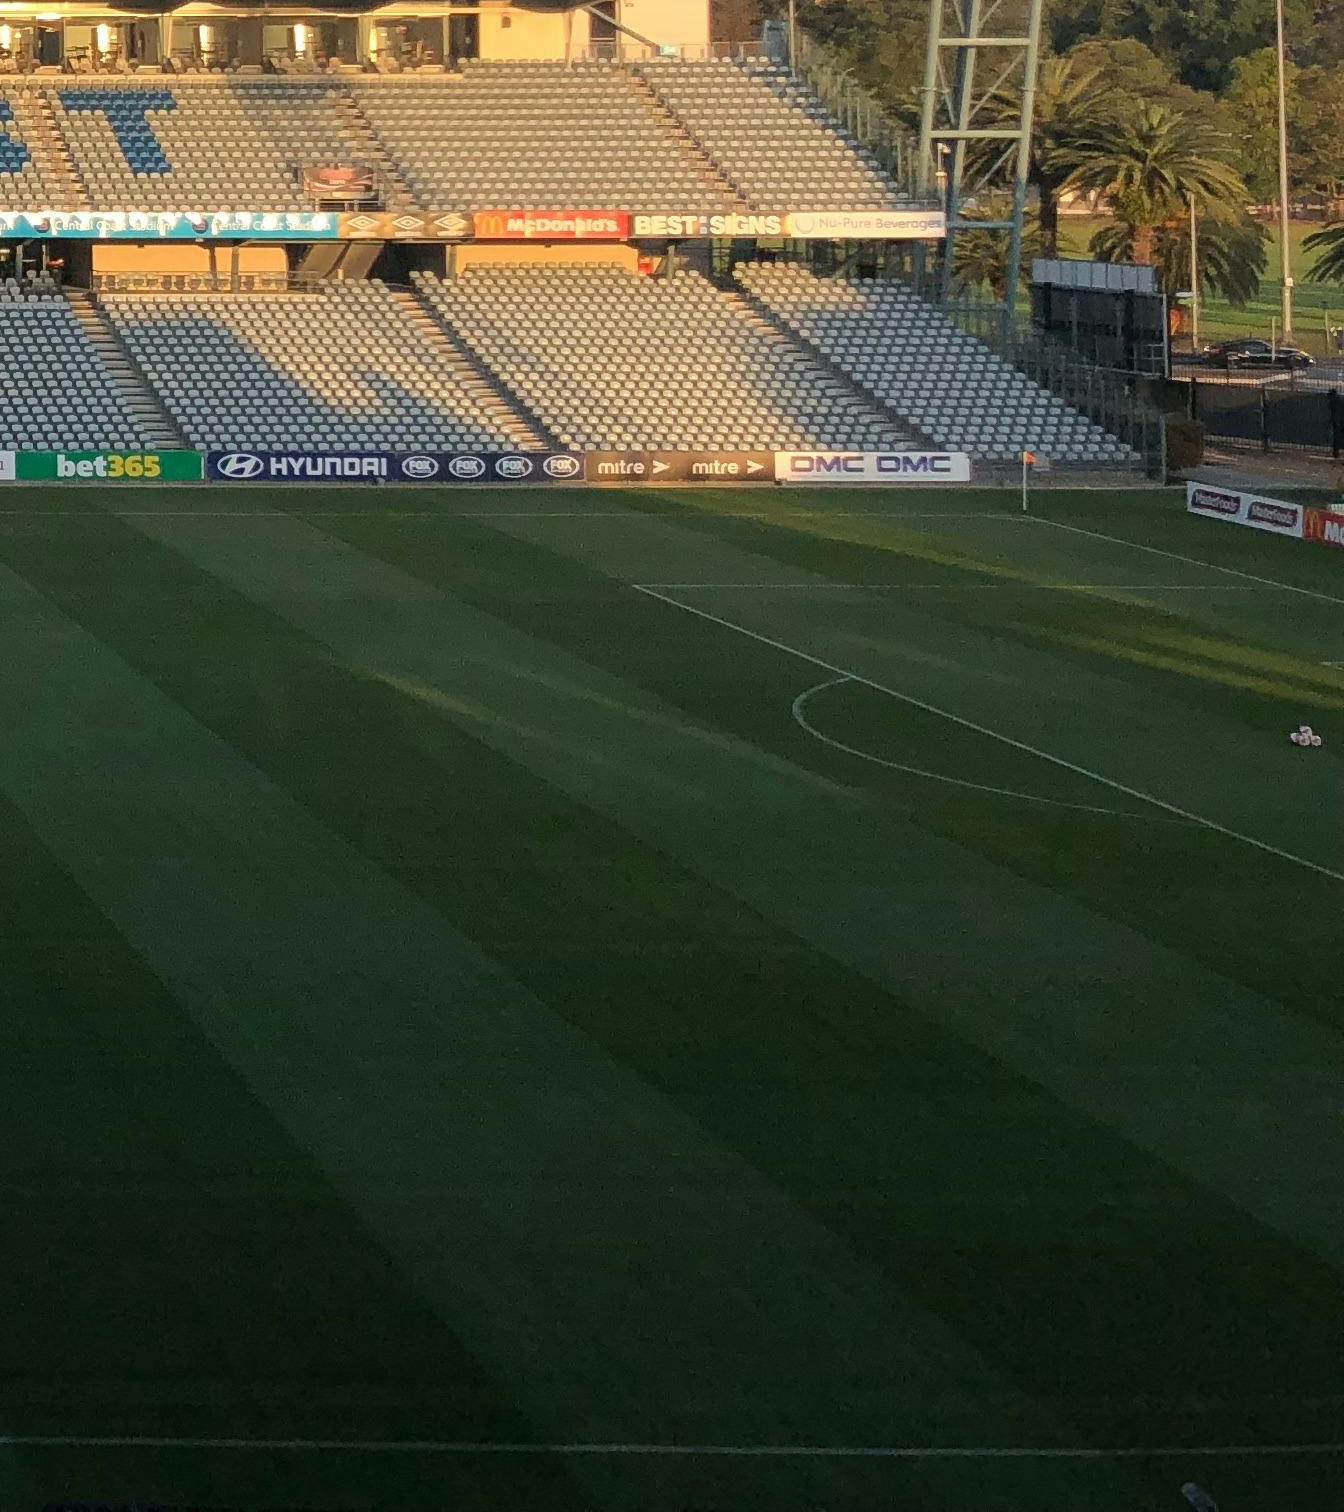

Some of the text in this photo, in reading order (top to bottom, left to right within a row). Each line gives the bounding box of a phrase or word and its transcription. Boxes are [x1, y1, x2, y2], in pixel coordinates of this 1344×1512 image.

[507, 218, 618, 233] McDonald's
[635, 216, 781, 234] BEST SIGNS
[819, 218, 941, 232] Nu-Pure Beverages
[56, 454, 161, 478] bet365
[270, 456, 387, 476] HYUNDAI
[598, 461, 644, 475] mitre
[692, 461, 739, 475] mitre
[790, 456, 952, 473] DMC DMC
